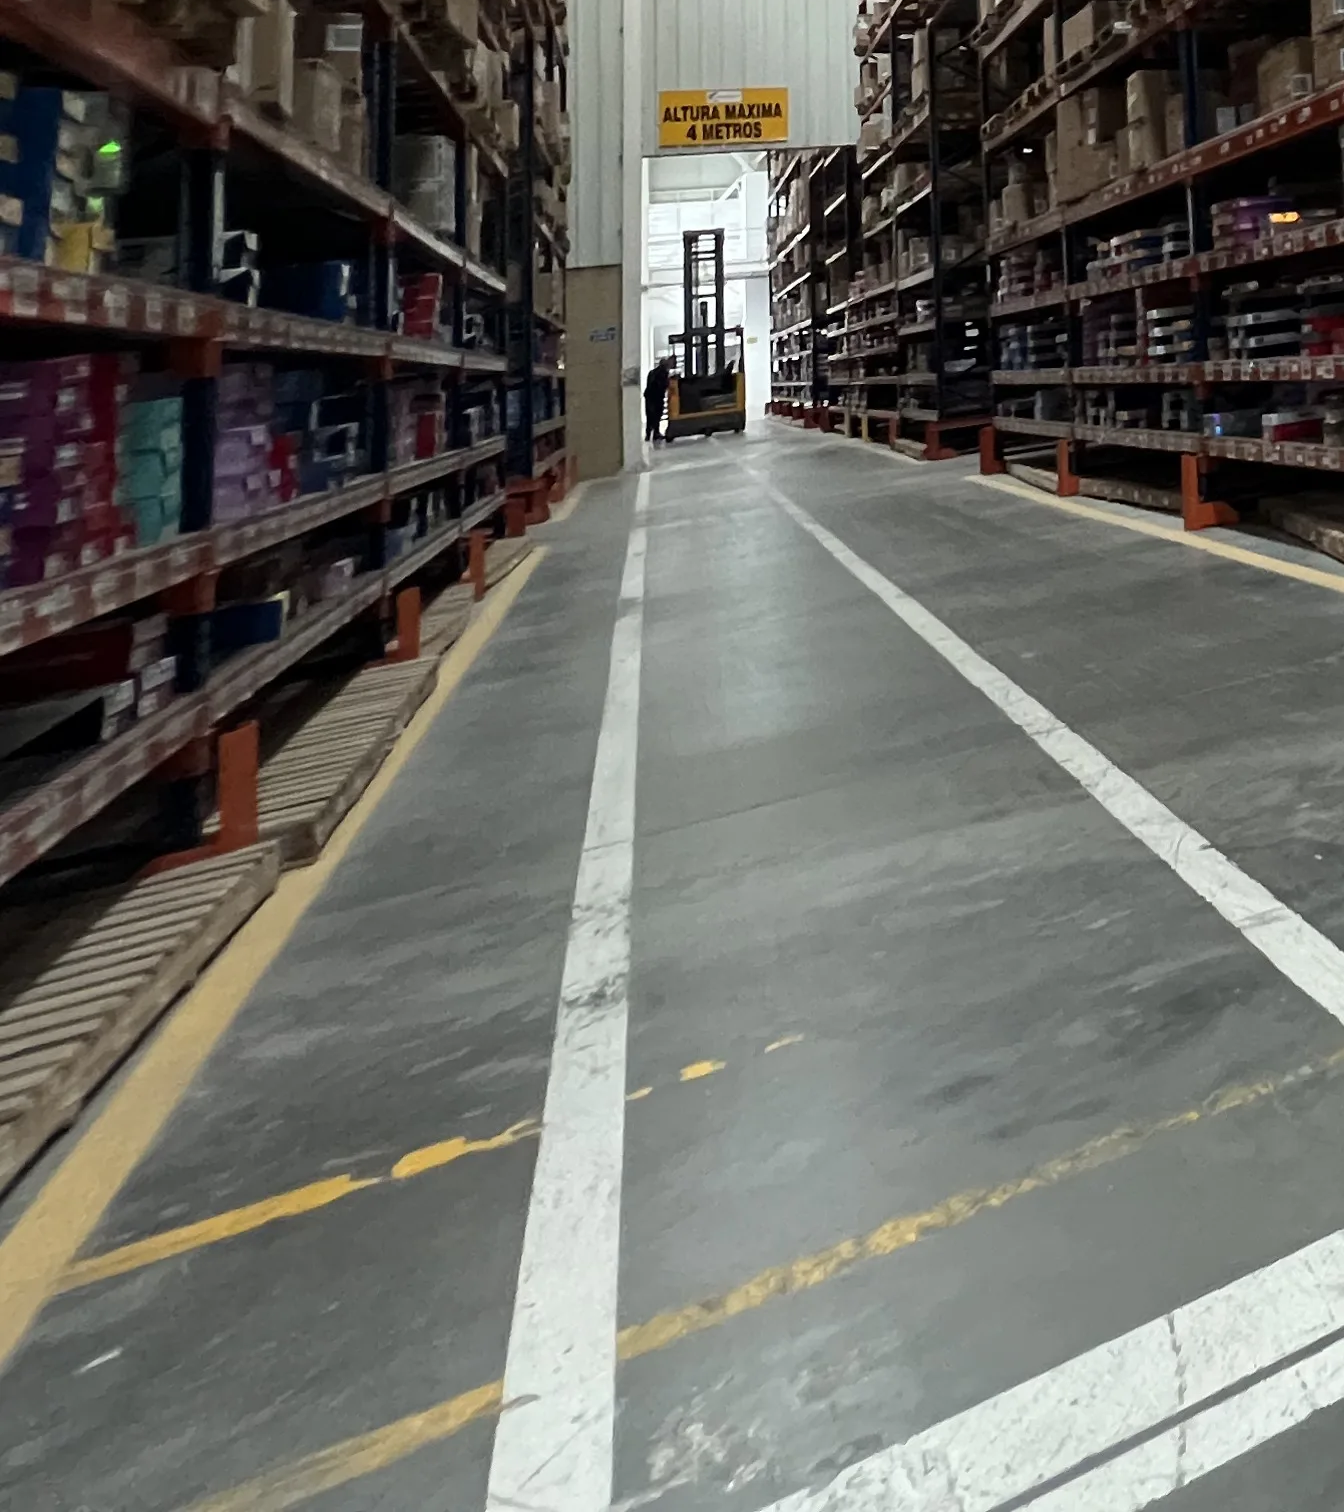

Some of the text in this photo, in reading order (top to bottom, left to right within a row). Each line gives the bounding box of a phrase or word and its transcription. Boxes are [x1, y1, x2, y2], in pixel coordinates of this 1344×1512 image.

[663, 103, 782, 122] ALTURA MAXIMA
[686, 121, 762, 140] 4 METROS
